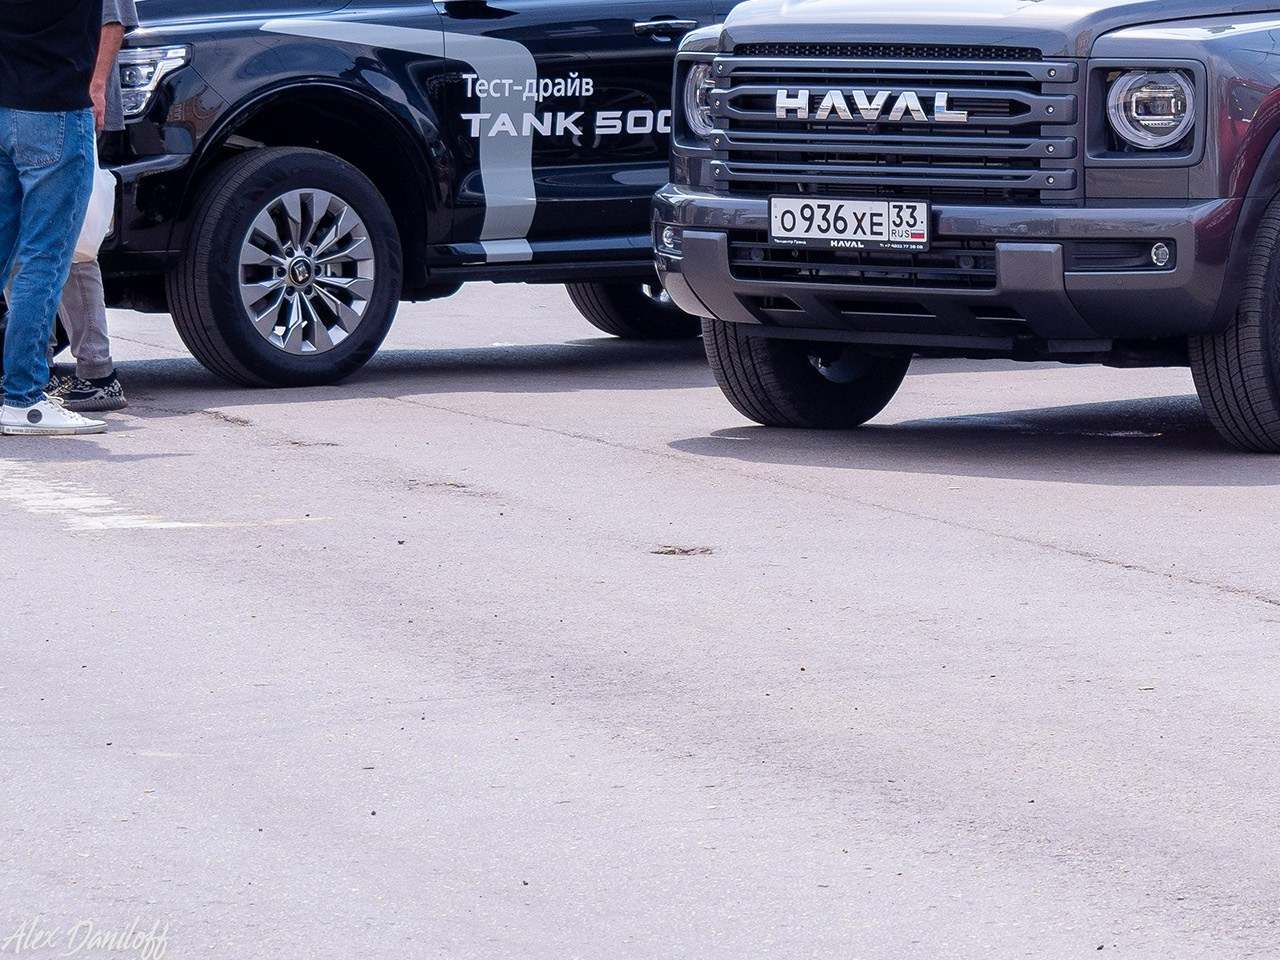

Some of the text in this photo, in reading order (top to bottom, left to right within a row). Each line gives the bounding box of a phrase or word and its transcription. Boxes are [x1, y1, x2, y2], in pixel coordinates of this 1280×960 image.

[462, 72, 594, 102] Тест-драйв
[775, 89, 968, 123] HAVAL
[460, 111, 585, 137] TANK
[892, 205, 917, 228] 33
[830, 240, 864, 248] HAVAL
[891, 229, 910, 238] RUS
